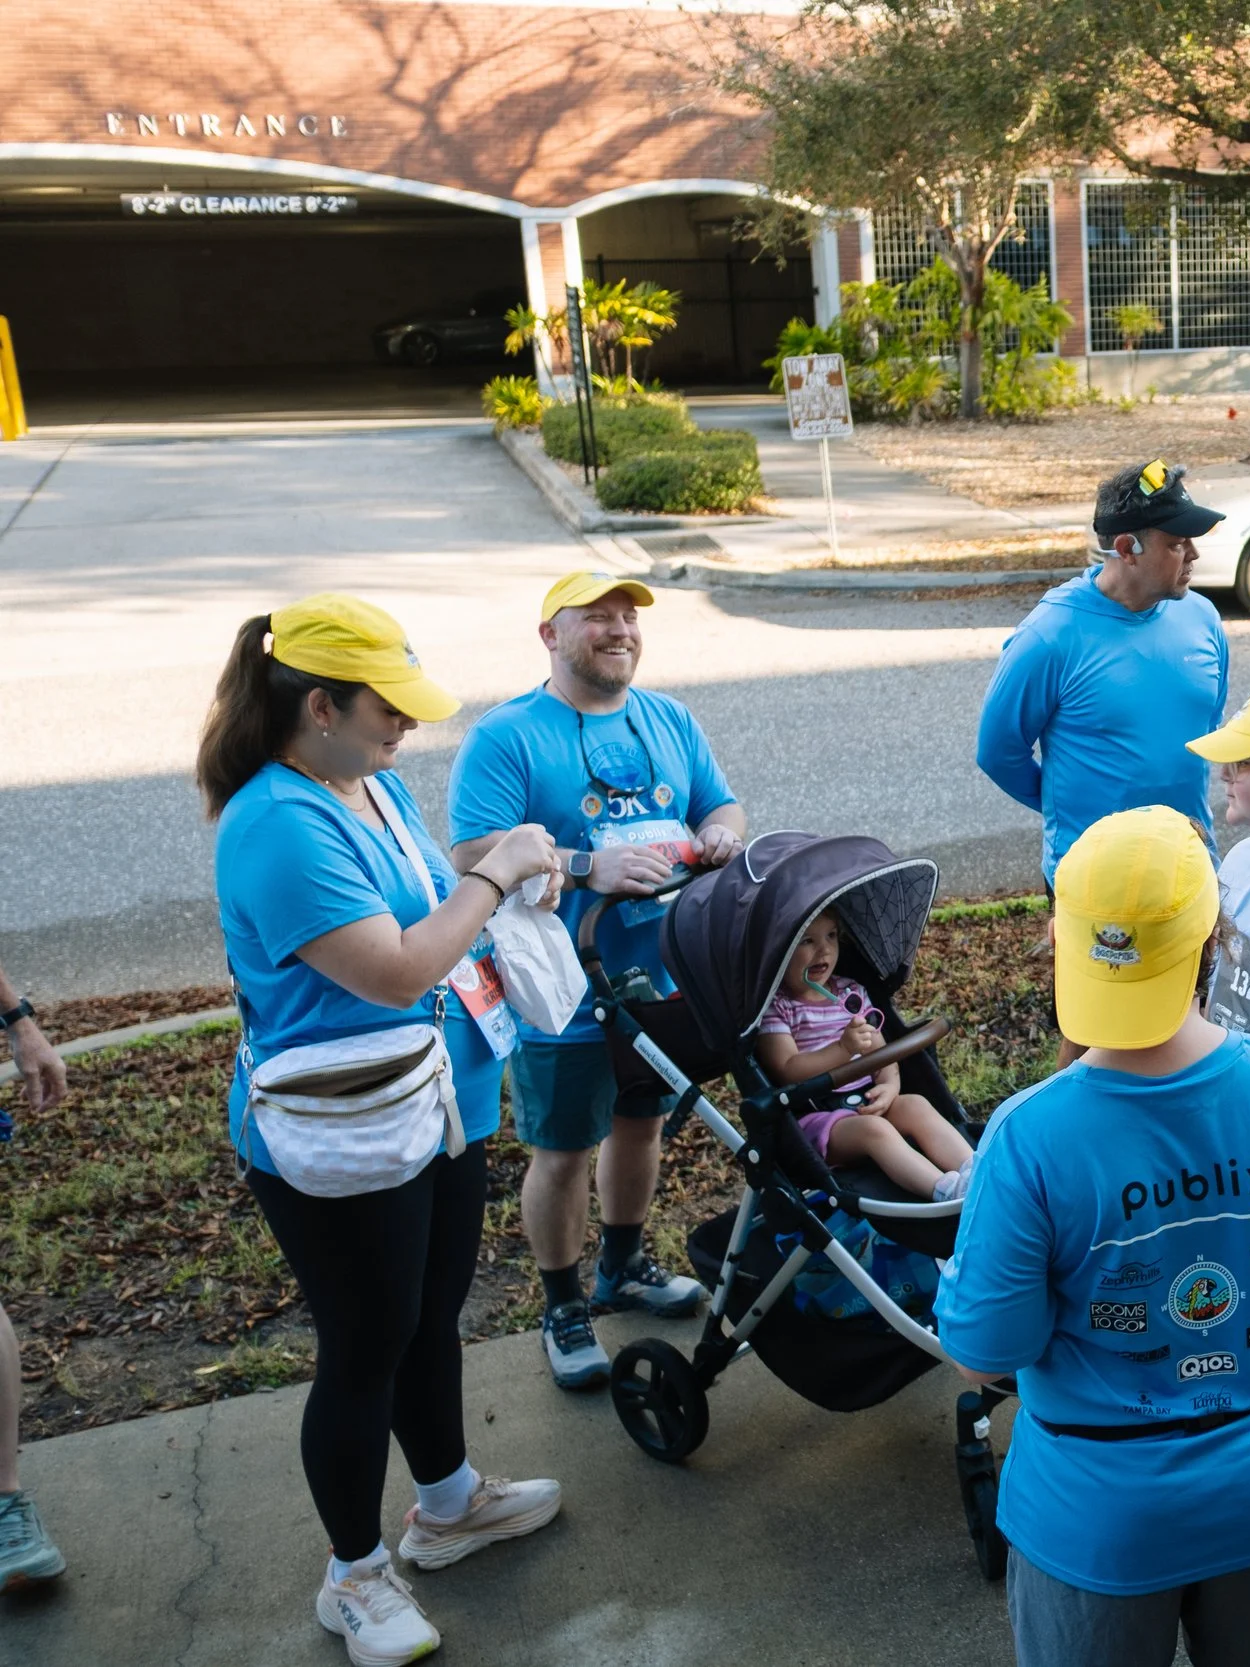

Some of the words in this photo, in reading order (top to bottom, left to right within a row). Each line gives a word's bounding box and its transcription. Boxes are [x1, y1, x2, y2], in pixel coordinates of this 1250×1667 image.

[106, 112, 349, 137] ENTRANCE
[179, 196, 303, 213] CLEARANCE
[1091, 1303, 1146, 1317] ROOMS
[1092, 1317, 1112, 1329] TO
[1113, 1319, 1140, 1333] GO
[1180, 1355, 1235, 1378] Q105
[1122, 1406, 1154, 1415] TAMPA
[1156, 1406, 1172, 1415] BAY
[337, 1598, 363, 1636] HOKA
